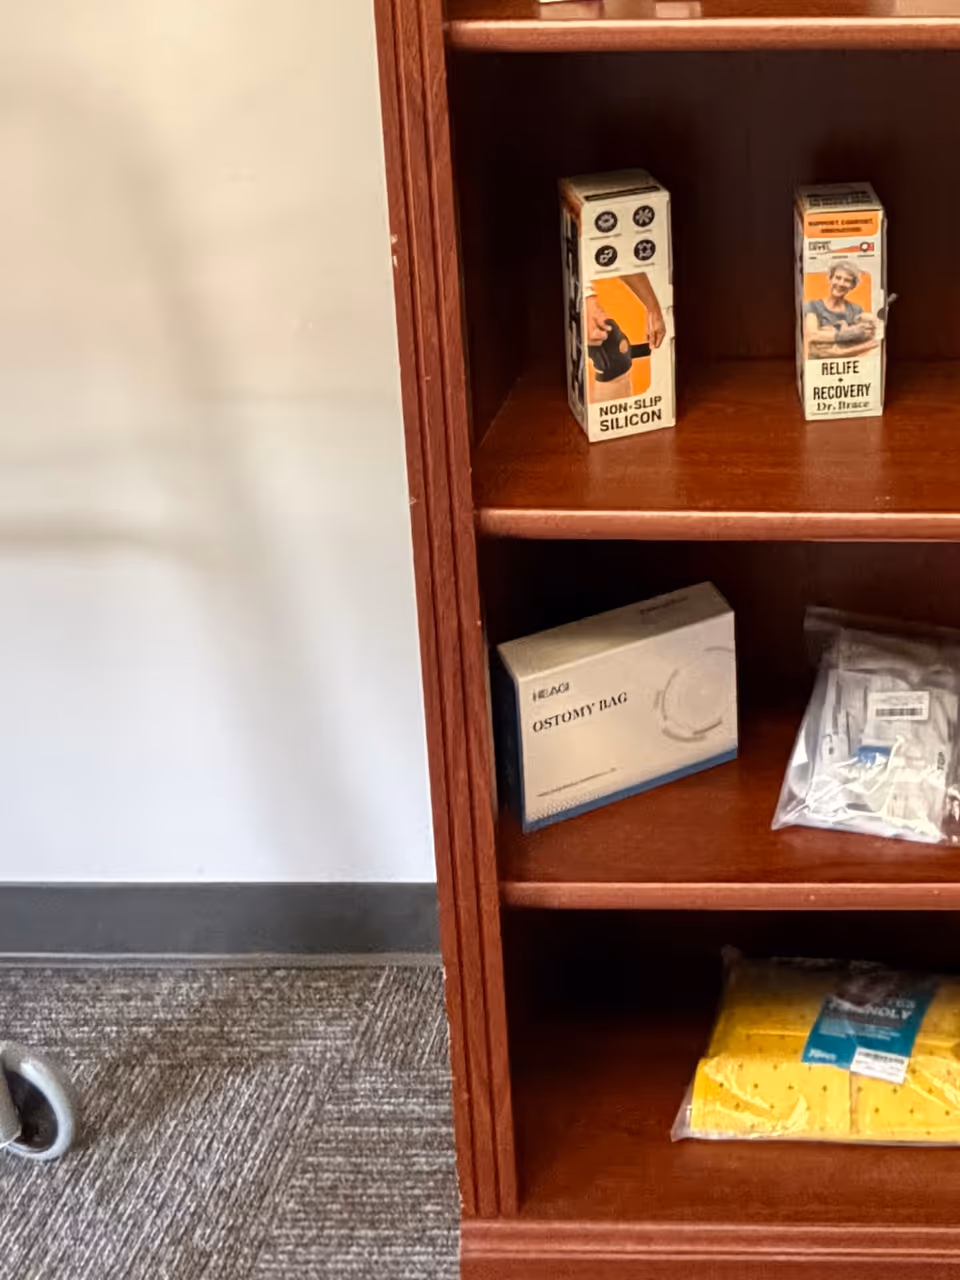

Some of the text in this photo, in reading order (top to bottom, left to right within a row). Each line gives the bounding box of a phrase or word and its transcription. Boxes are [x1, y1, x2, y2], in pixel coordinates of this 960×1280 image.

[822, 360, 860, 376] RELIFE
[813, 382, 871, 400] RECOVERY
[600, 408, 662, 432] SILICON
[533, 692, 628, 733] OSTOMY BAG
